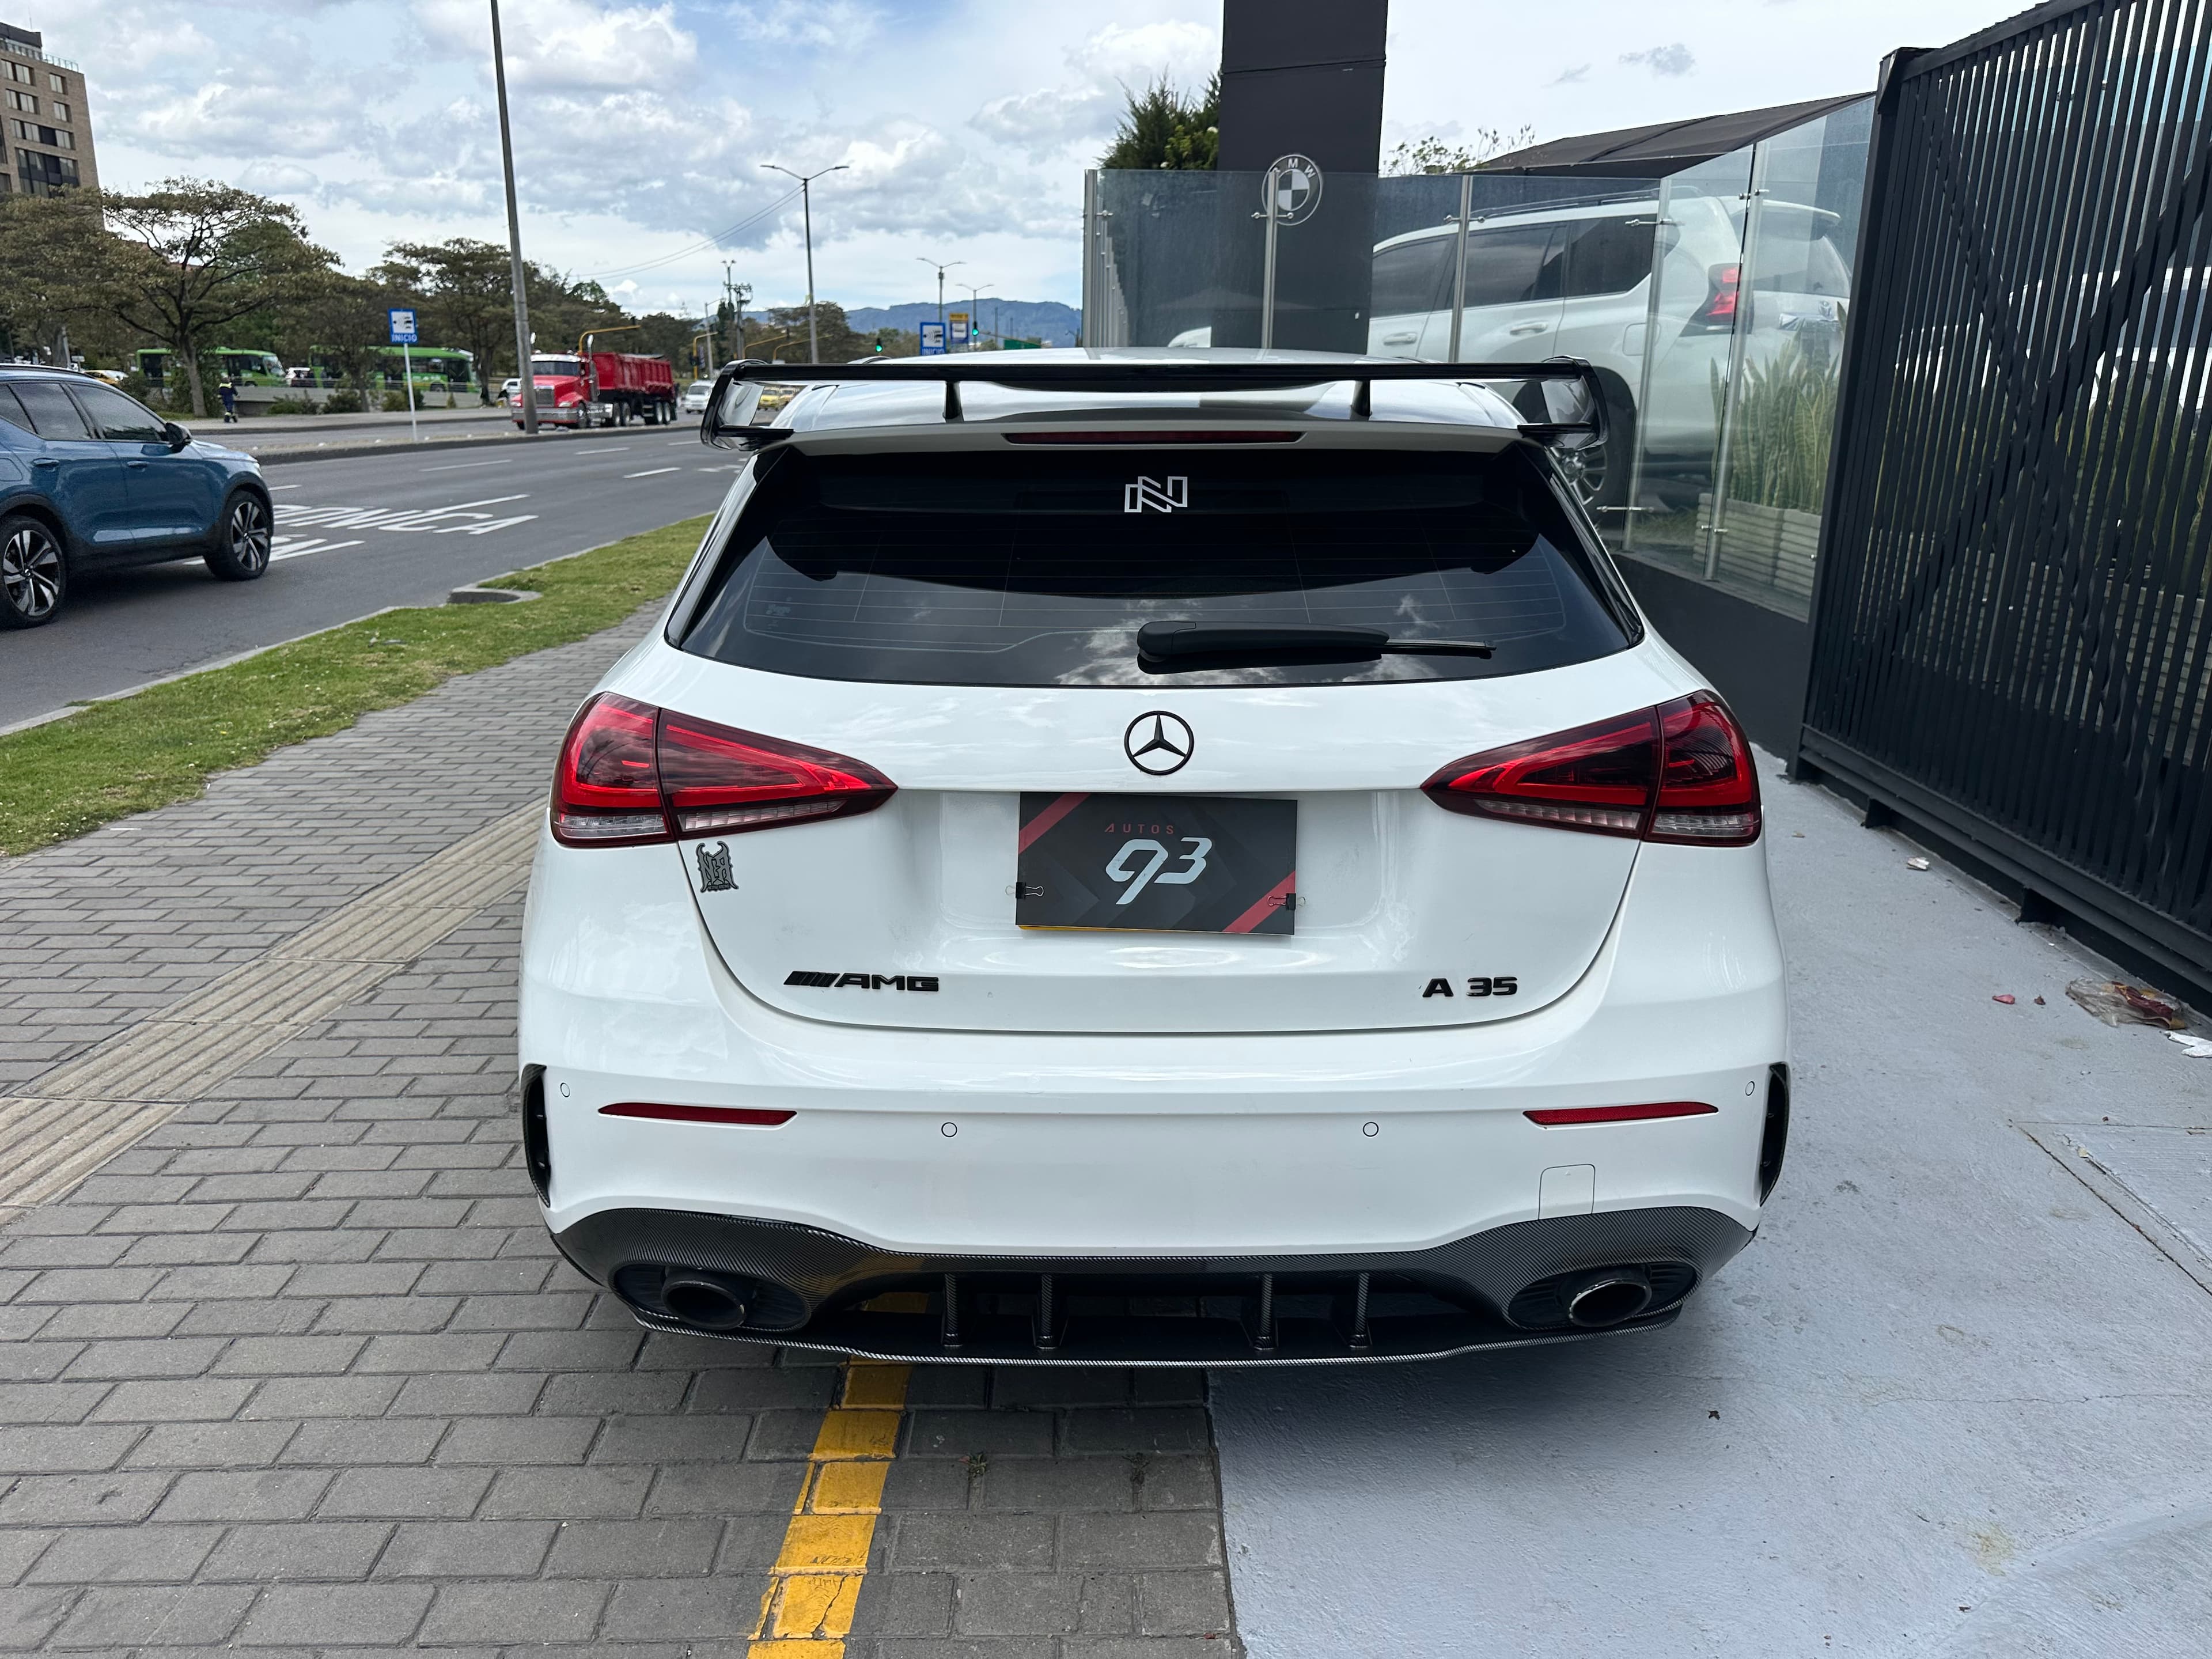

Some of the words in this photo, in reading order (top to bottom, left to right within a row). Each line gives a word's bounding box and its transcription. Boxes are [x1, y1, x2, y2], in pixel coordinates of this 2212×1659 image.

[392, 334, 417, 342] INICIO
[1104, 823, 1175, 835] AUTOS
[1105, 836, 1213, 906] 93
[834, 973, 939, 992] AMG
[1422, 978, 1454, 998] A
[1466, 976, 1518, 997] 35
